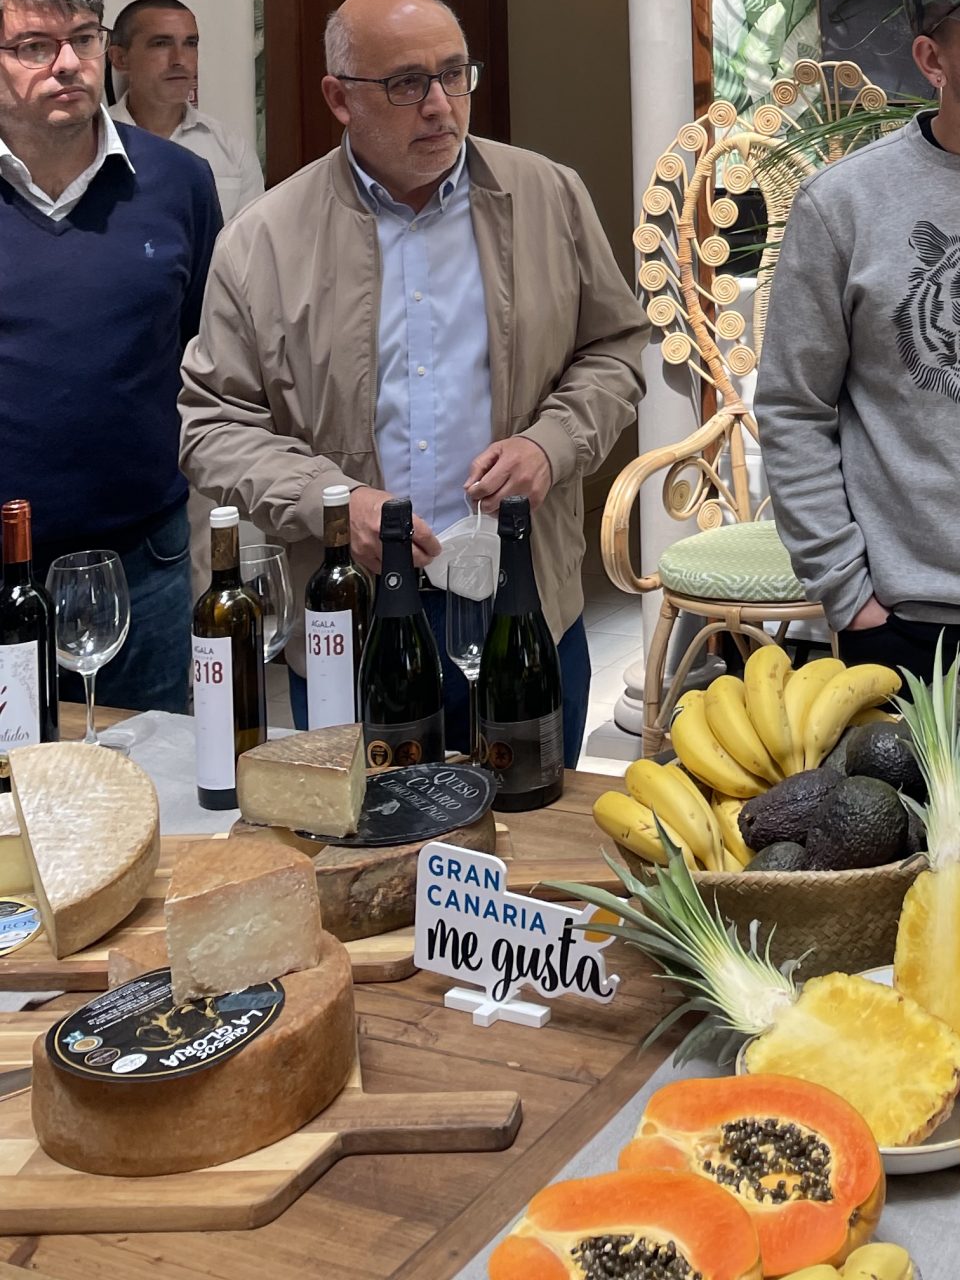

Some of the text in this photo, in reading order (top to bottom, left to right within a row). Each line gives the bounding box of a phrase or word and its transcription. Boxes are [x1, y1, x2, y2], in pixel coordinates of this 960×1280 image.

[308, 633, 344, 657] 1318
[406, 777, 462, 810] CANARIO
[433, 771, 480, 799] QUESO
[428, 855, 500, 892] GRAN
[427, 885, 547, 936] CANARIA
[427, 917, 614, 1003] me gusta
[230, 1009, 263, 1026] LA
[159, 1025, 233, 1067] GLORIA
[196, 1026, 248, 1060] QUESOS
